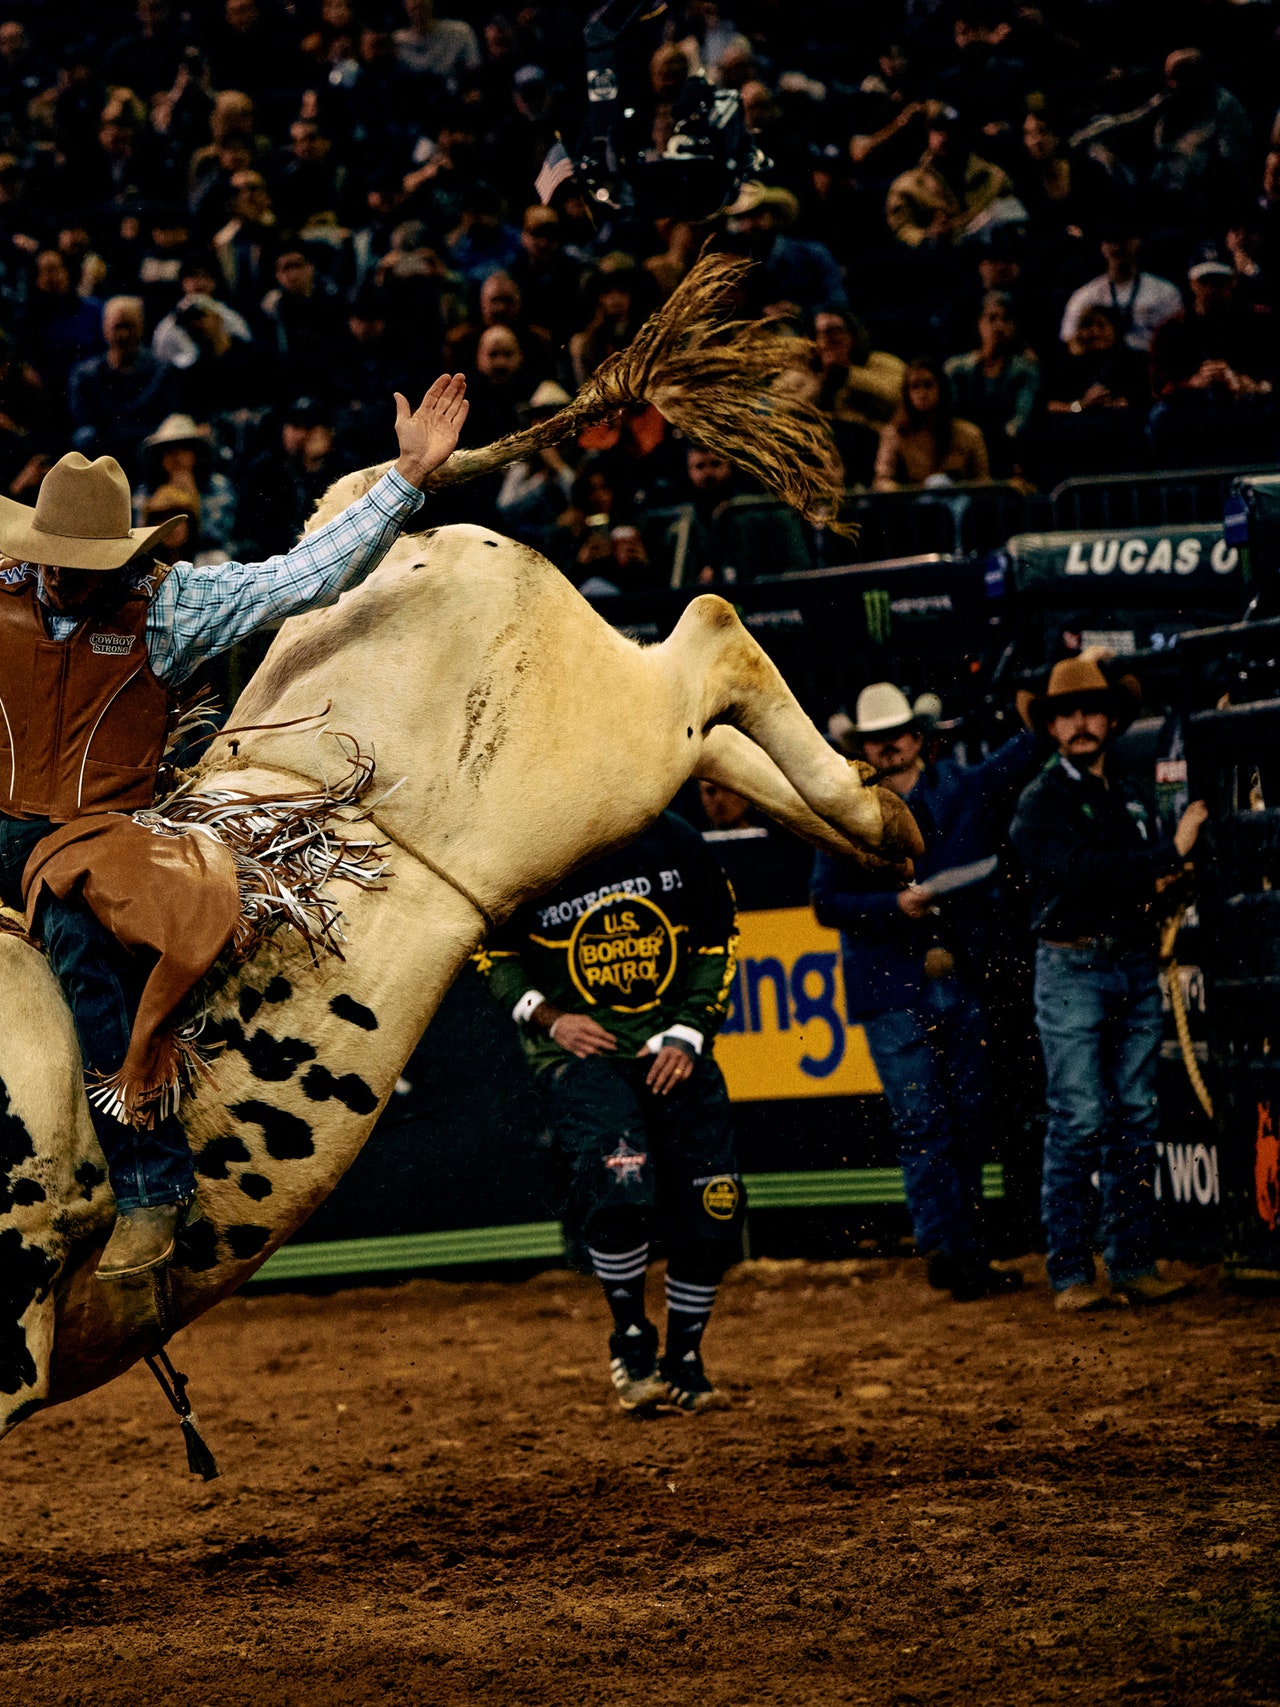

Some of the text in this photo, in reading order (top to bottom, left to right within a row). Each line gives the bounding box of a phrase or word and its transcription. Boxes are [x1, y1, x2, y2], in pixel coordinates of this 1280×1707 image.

[1064, 538, 1203, 576] LUCAS
[91, 635, 134, 646] COWBOY
[94, 644, 129, 653] STRONG
[581, 935, 664, 966] BORDER
[585, 959, 660, 988] PATROL
